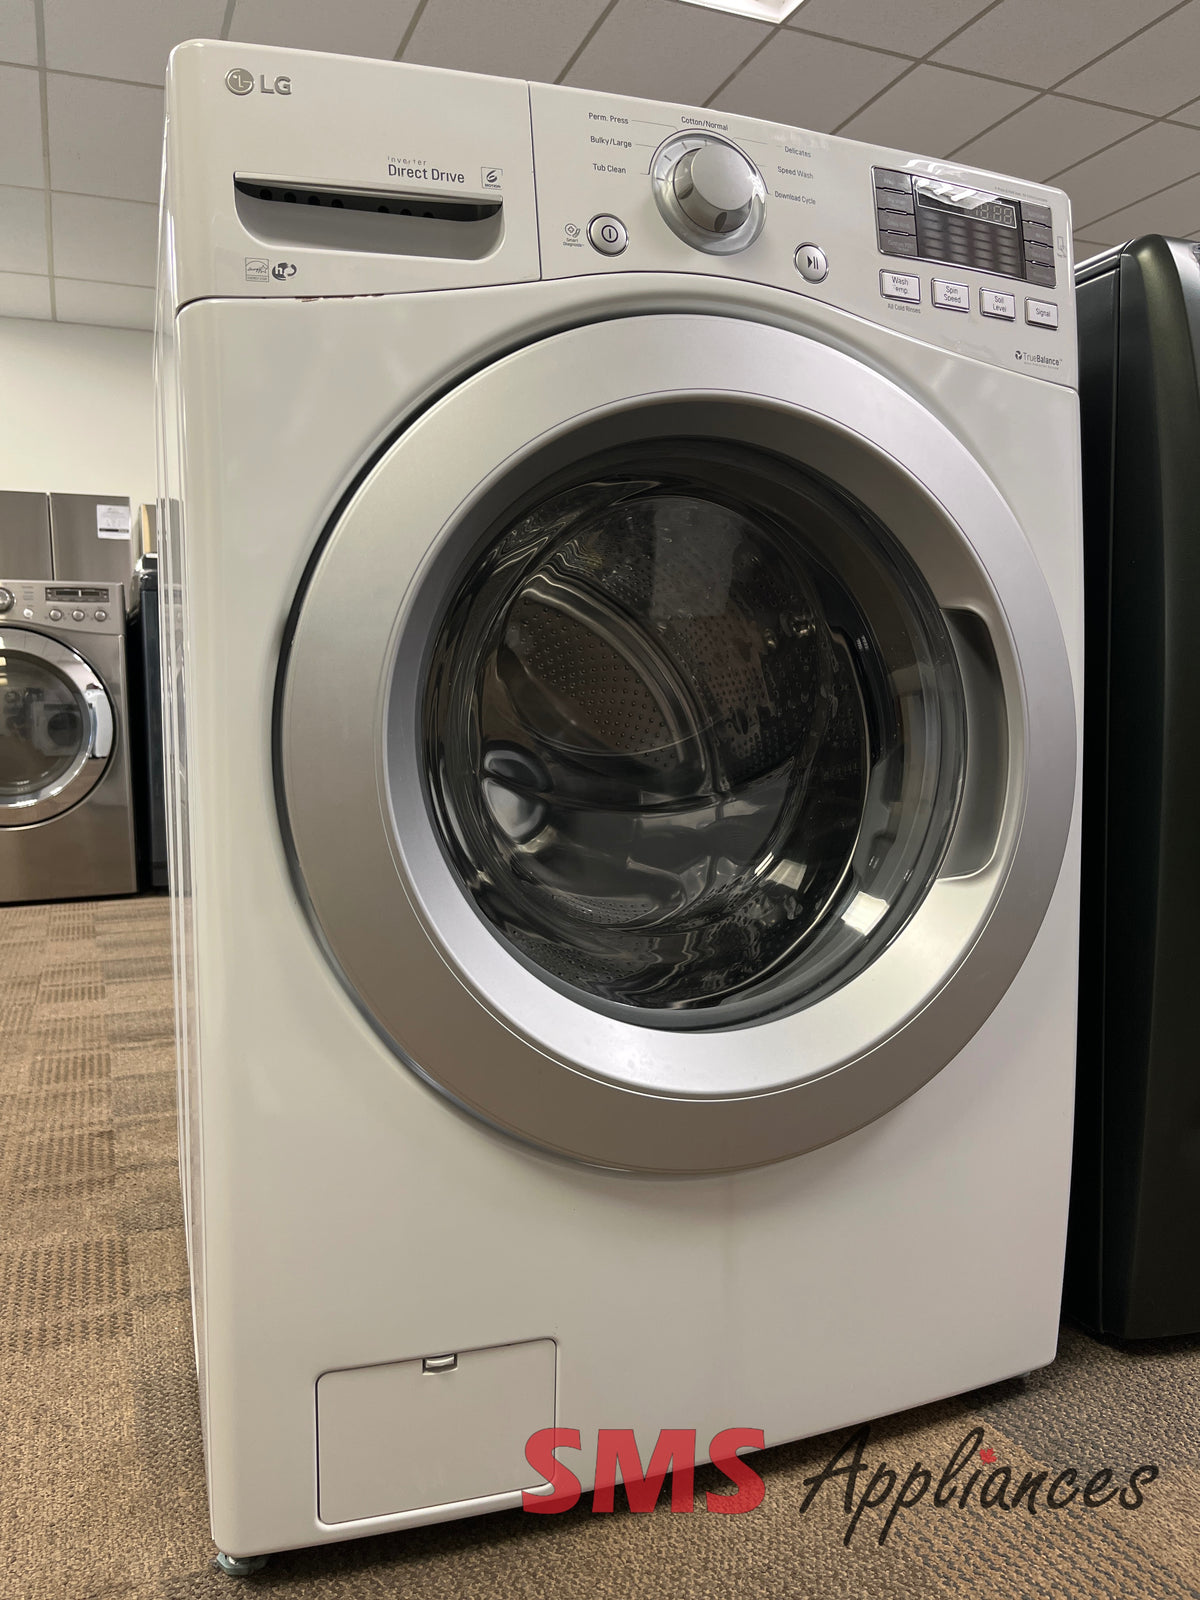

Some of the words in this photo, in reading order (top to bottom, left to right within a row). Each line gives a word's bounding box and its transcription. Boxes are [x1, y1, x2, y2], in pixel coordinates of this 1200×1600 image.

[260, 74, 292, 96] LG
[588, 112, 607, 121] Perm.
[609, 115, 629, 125] Press
[681, 116, 729, 131] Cotton/Normal
[590, 136, 632, 148] Bulky/Large
[784, 145, 812, 158] Delicates
[388, 164, 428, 180] Direct
[431, 168, 465, 184] Drive
[592, 163, 606, 172] Tub
[607, 165, 627, 174] Clean
[777, 165, 797, 176] Speed
[797, 169, 814, 180] Wash
[774, 190, 801, 202] Download
[891, 276, 909, 286] Wash
[945, 285, 959, 295] Spin
[943, 293, 962, 304] Speed
[994, 295, 1005, 304] Soil
[992, 303, 1007, 313] Level
[1035, 307, 1051, 318] Signal
